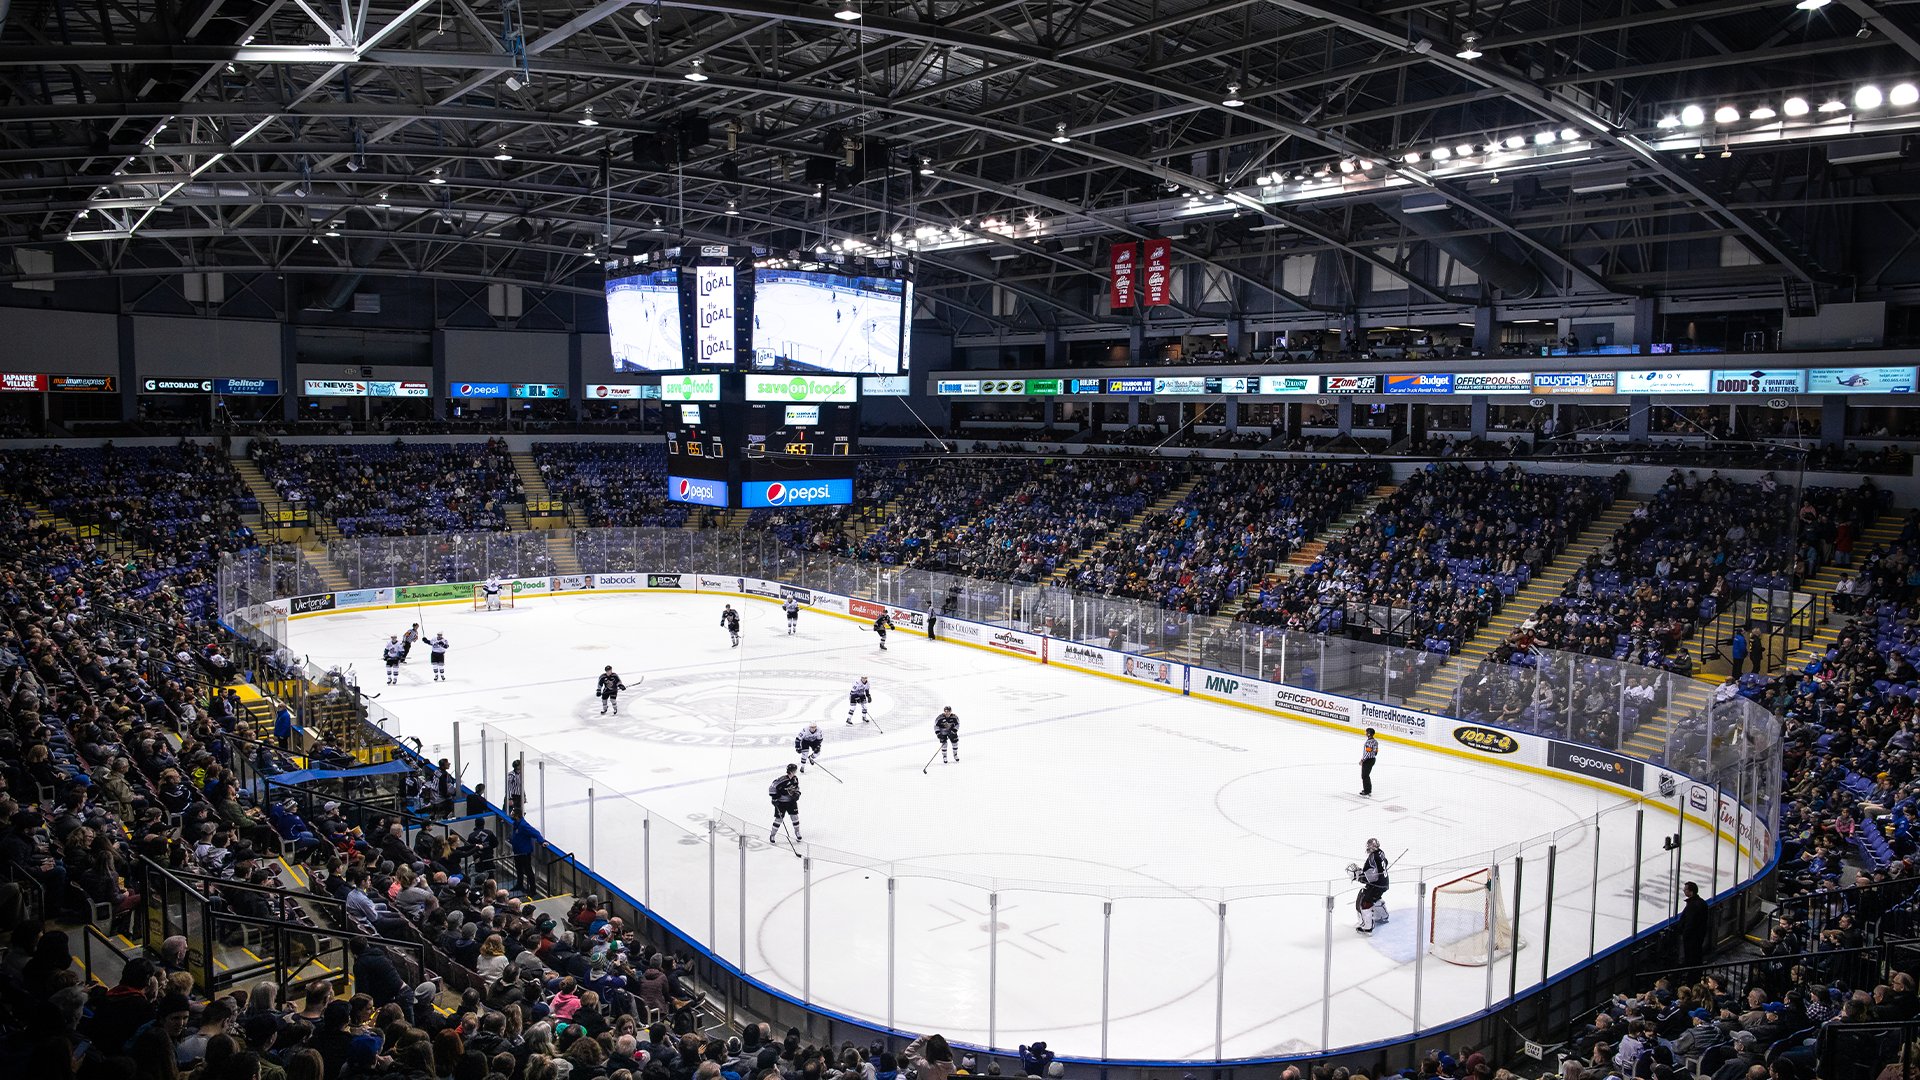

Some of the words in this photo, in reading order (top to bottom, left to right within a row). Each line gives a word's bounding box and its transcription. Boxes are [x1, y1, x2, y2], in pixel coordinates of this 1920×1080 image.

[700, 276, 732, 296] LOCAL
[700, 308, 732, 328] LOCAL
[700, 340, 732, 360] LOCAL
[3, 374, 37, 382] JAPANESE
[228, 379, 264, 387] Belltech
[1420, 376, 1449, 386] Budget
[474, 386, 499, 394] pepsi
[1717, 379, 1759, 392] DODD'S
[691, 485, 714, 499] pepsi
[789, 484, 830, 502] pepsi
[523, 580, 545, 589] foods
[600, 576, 636, 584] babcock
[295, 597, 328, 612] Victoria
[1140, 661, 1155, 671] CHEK
[1205, 675, 1239, 694] MNP
[1277, 690, 1349, 713] OFFICEPOOLS.com
[1361, 703, 1426, 728] PreferredHomes.ca
[1569, 754, 1613, 772] regroove
